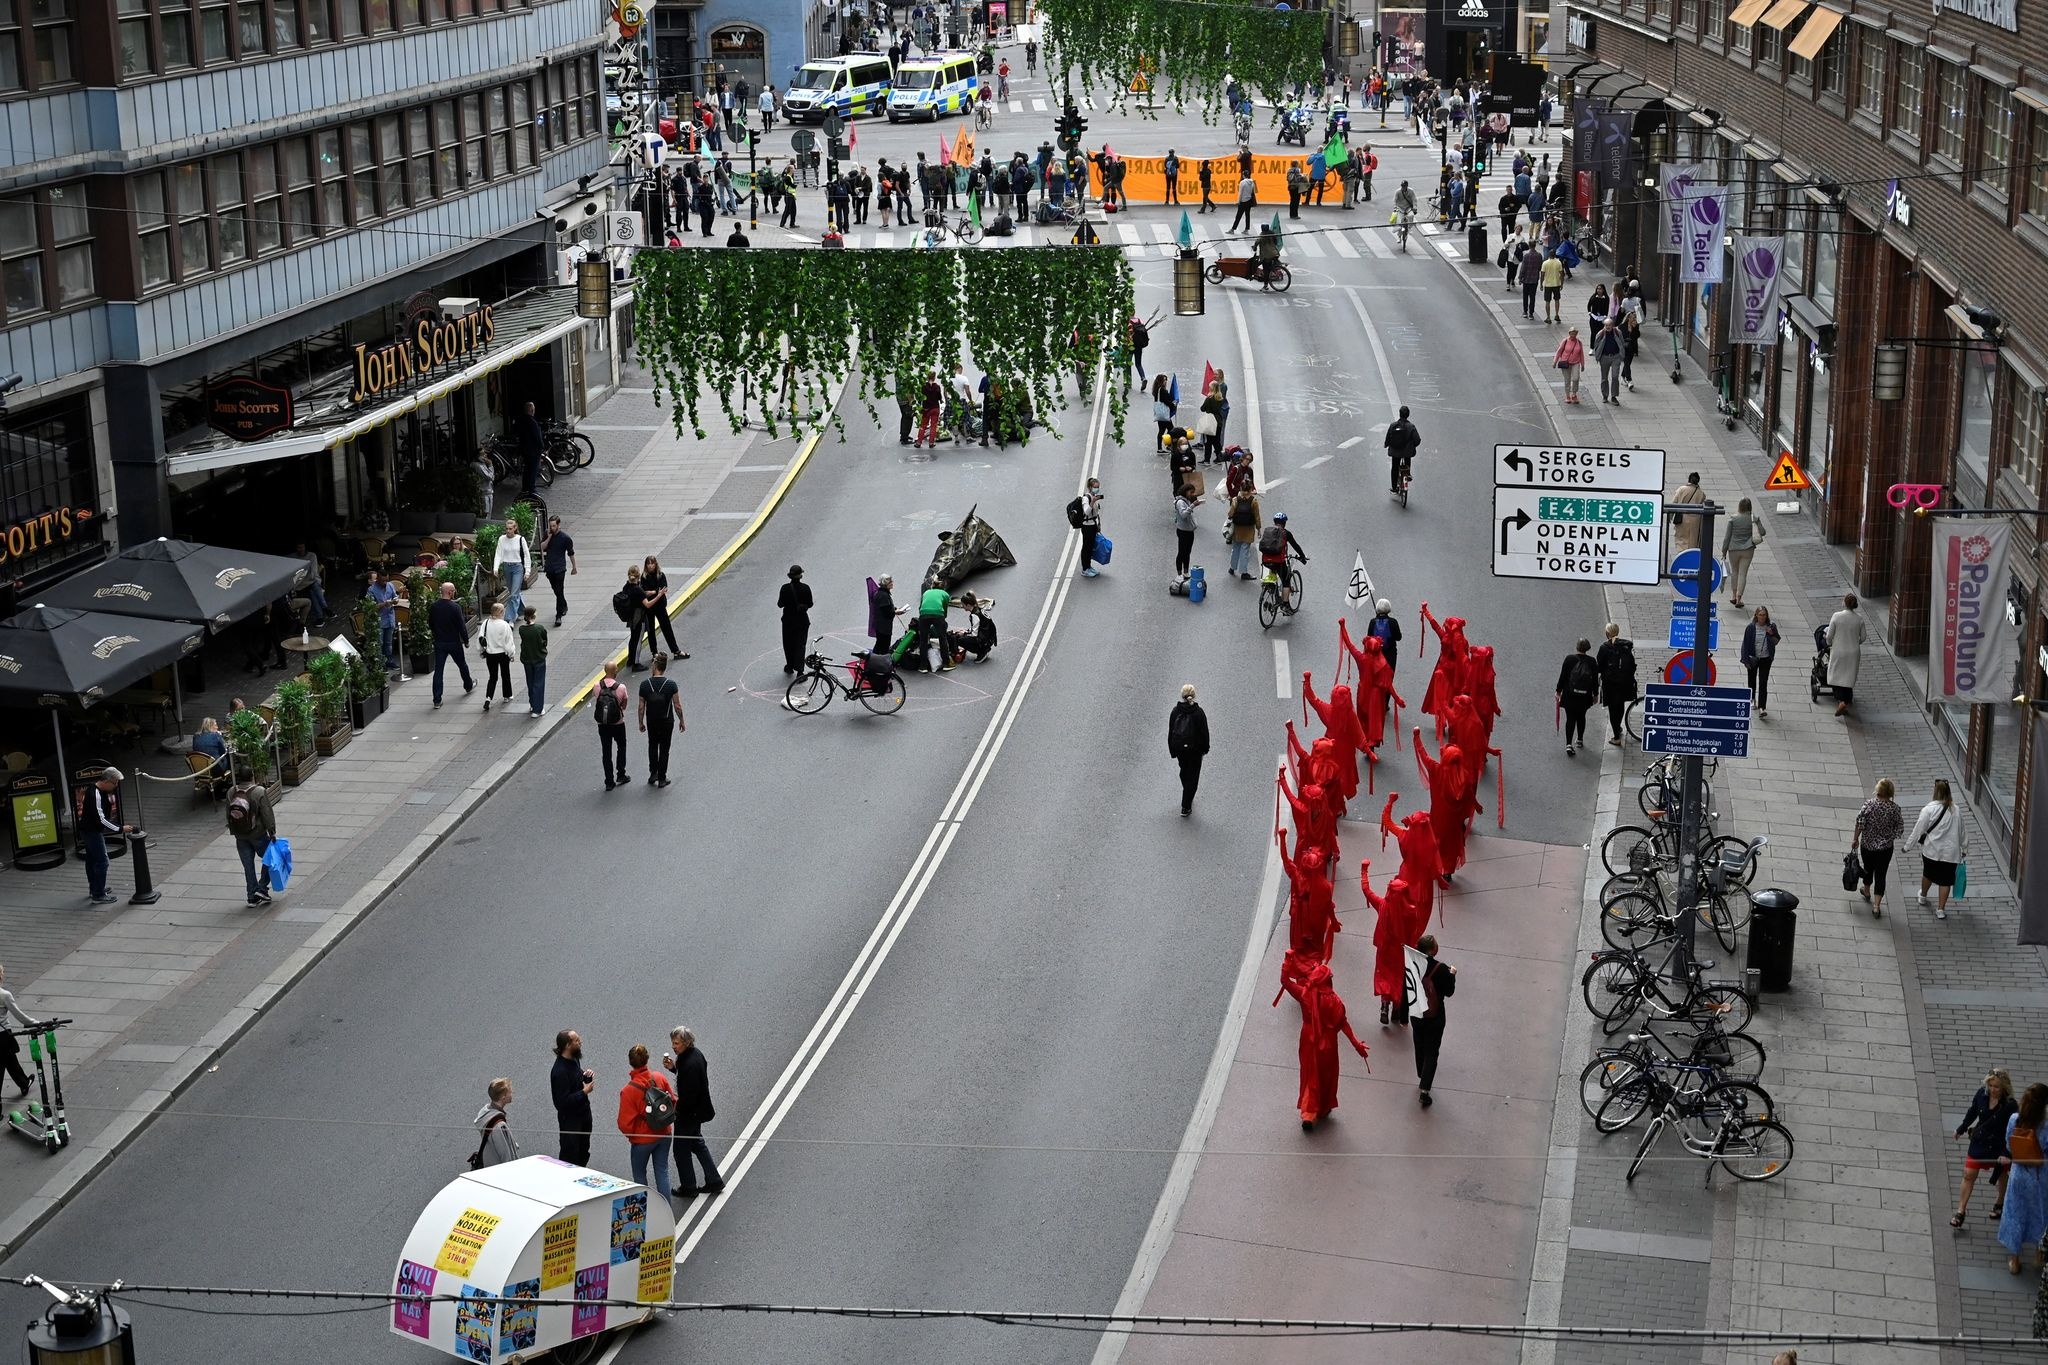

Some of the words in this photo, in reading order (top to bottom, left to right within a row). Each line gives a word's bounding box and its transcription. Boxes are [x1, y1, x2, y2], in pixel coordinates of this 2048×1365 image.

[1458, 8, 1489, 18] adidas
[650, 140, 663, 164] T
[1612, 146, 1622, 180] telenor
[617, 217, 634, 240] 3
[1694, 230, 1712, 272] Telia
[1744, 284, 1766, 333] Telia
[354, 342, 413, 402] JOHN
[417, 305, 494, 373] SCOTT'S
[215, 400, 238, 413] JOHN
[239, 400, 279, 414] SCOTT'S
[1539, 451, 1631, 468] SERGELS
[1539, 468, 1595, 483] TORG
[1550, 502, 1575, 516] E4
[1599, 504, 1641, 520] E20
[1538, 524, 1649, 542] ODENPLAN
[1538, 540, 1549, 554] N
[1564, 542, 1618, 557] BAN-
[1537, 557, 1616, 574] TORGET
[93, 586, 152, 601] KOPPARBERG
[1946, 582, 1956, 651] HOBBY
[1956, 564, 1989, 691] Panduro
[1668, 699, 1706, 707] Fridhemsplan
[1668, 706, 1707, 714] Centralstation
[1666, 744, 1708, 753] Rådmansgatan
[1692, 739, 1722, 747] högskolan
[448, 1234, 482, 1250] MASSAKTION
[447, 1252, 467, 1265] STHLM
[544, 1247, 575, 1260] MASSAKTION
[402, 1263, 432, 1286] CIVIL
[550, 1266, 568, 1277] STHLM
[576, 1266, 605, 1287] CIVIL
[640, 1267, 670, 1280] MASSAKTION
[645, 1284, 663, 1296] STHLM
